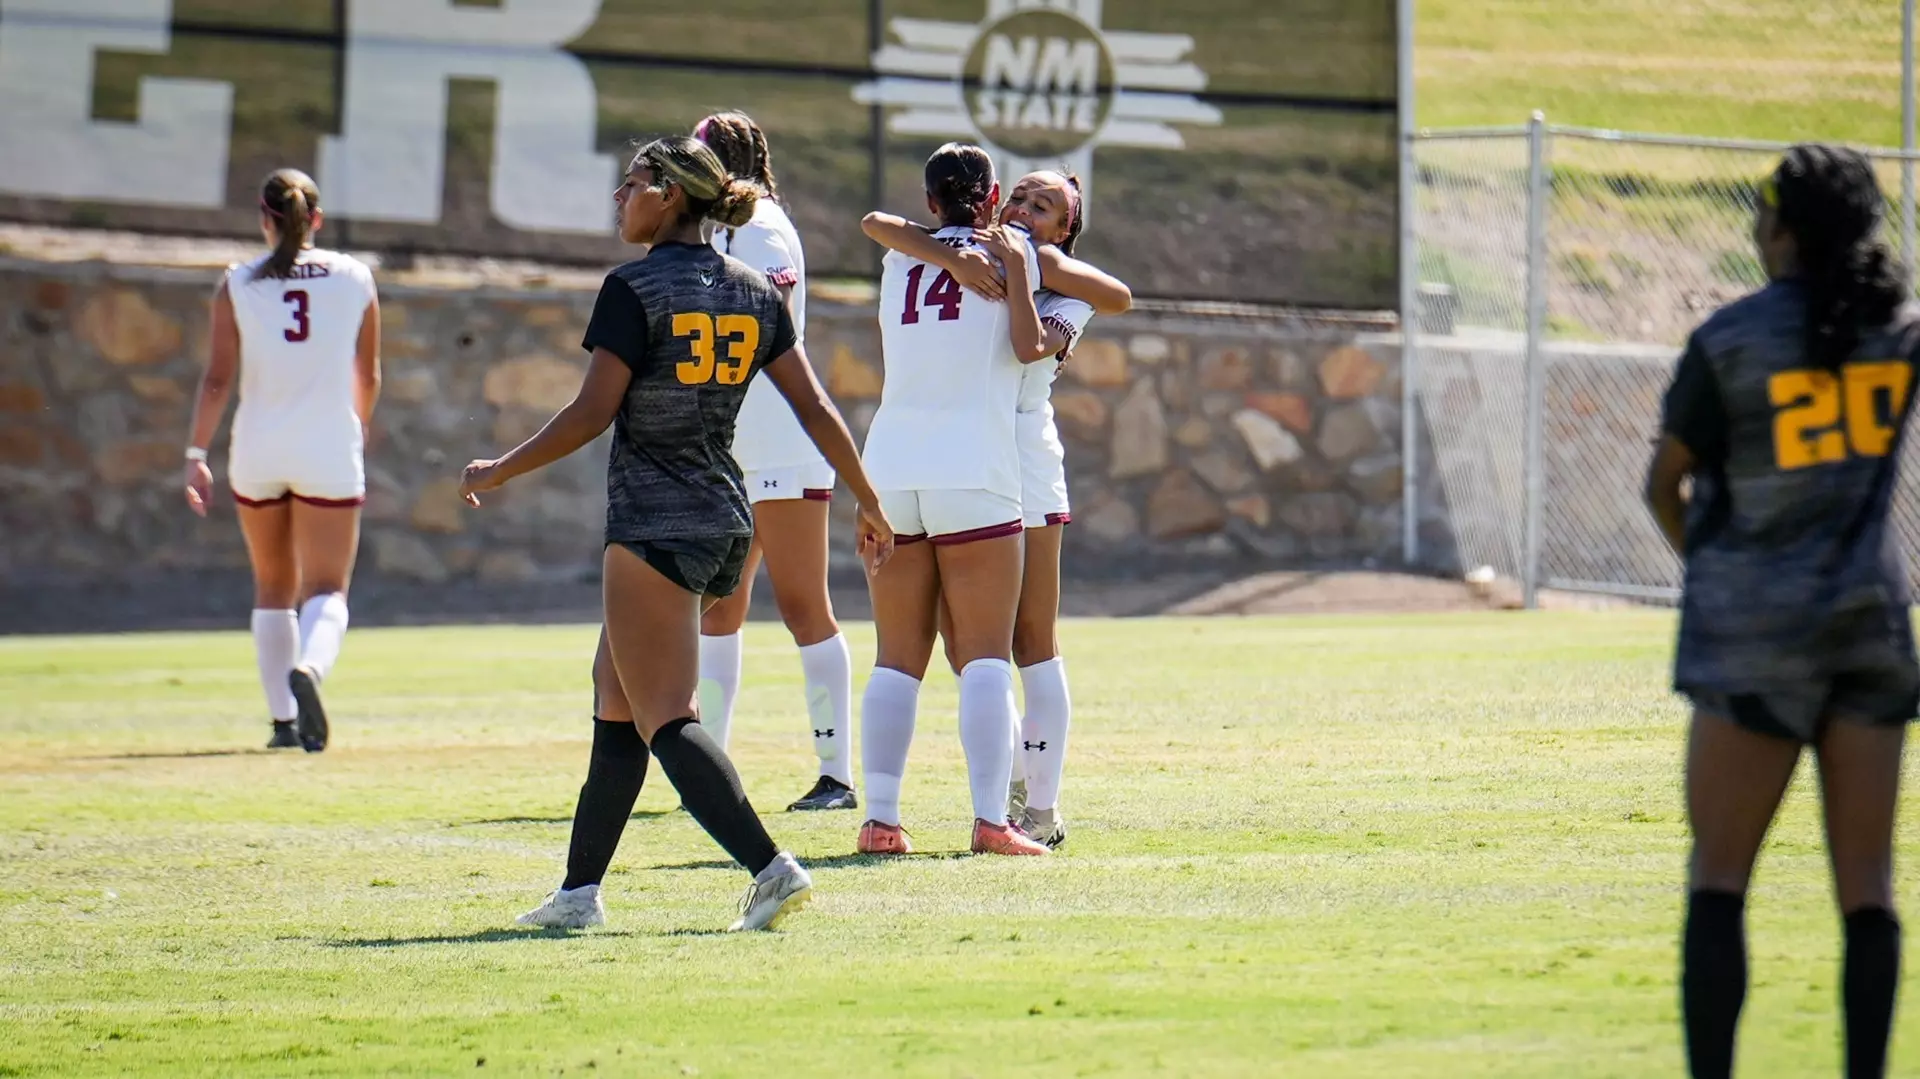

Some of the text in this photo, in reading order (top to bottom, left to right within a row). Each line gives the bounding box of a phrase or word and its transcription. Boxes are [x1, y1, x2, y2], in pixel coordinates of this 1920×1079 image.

[983, 33, 1099, 95] NM
[974, 91, 1098, 132] STATE
[282, 289, 310, 343] 3
[901, 263, 963, 325] 14
[671, 312, 760, 386] 33
[1767, 359, 1913, 471] 20
